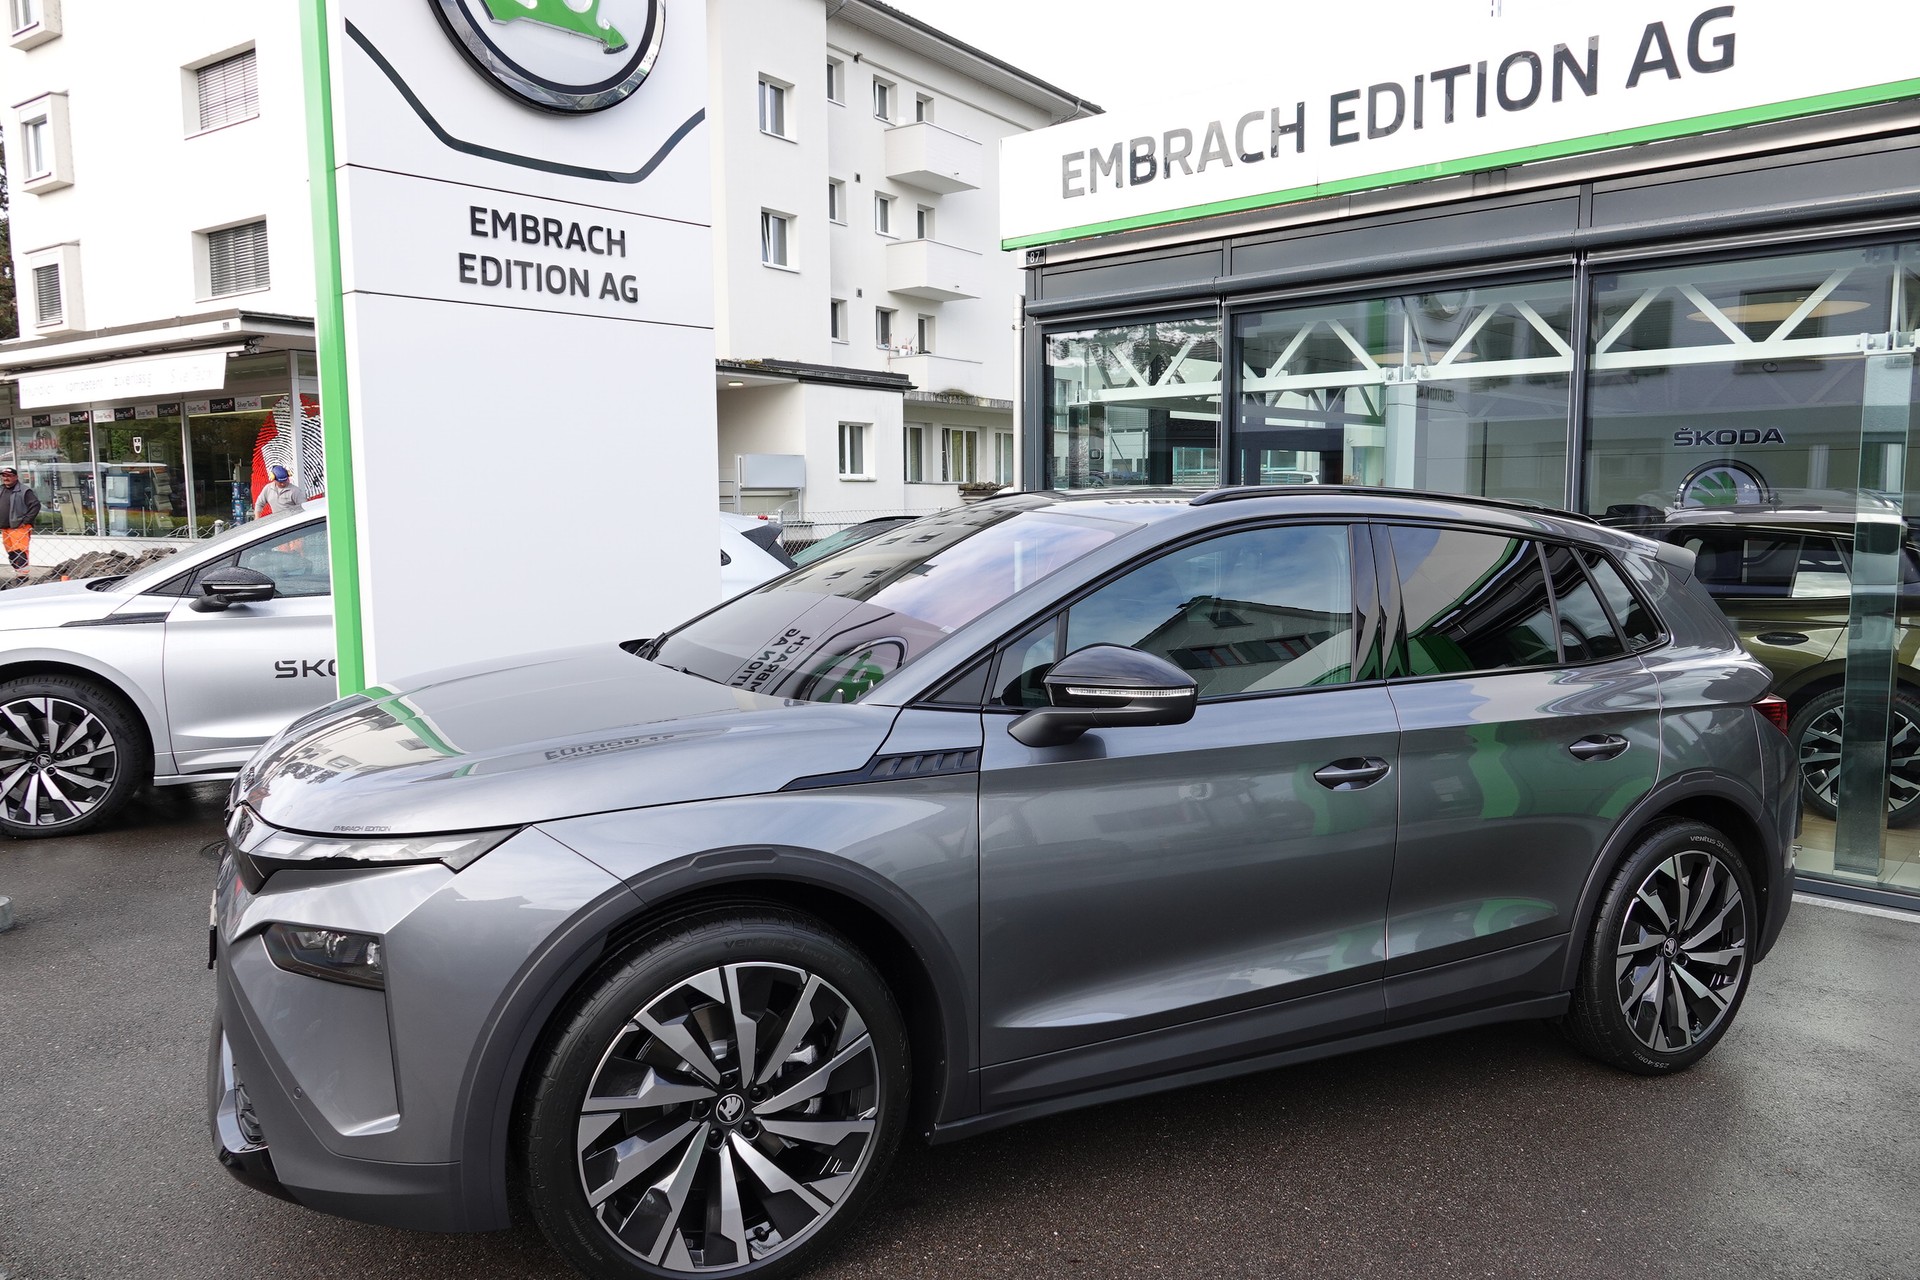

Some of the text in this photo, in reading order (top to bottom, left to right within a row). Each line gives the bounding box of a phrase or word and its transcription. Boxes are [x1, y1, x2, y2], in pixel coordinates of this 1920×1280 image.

[1061, 5, 1737, 200] EMBRACH EDITION AG
[469, 205, 627, 258] EMBRACH
[1030, 251, 1040, 263] 87
[458, 252, 639, 304] EDITION AG
[1674, 427, 1785, 446] ŠKODA
